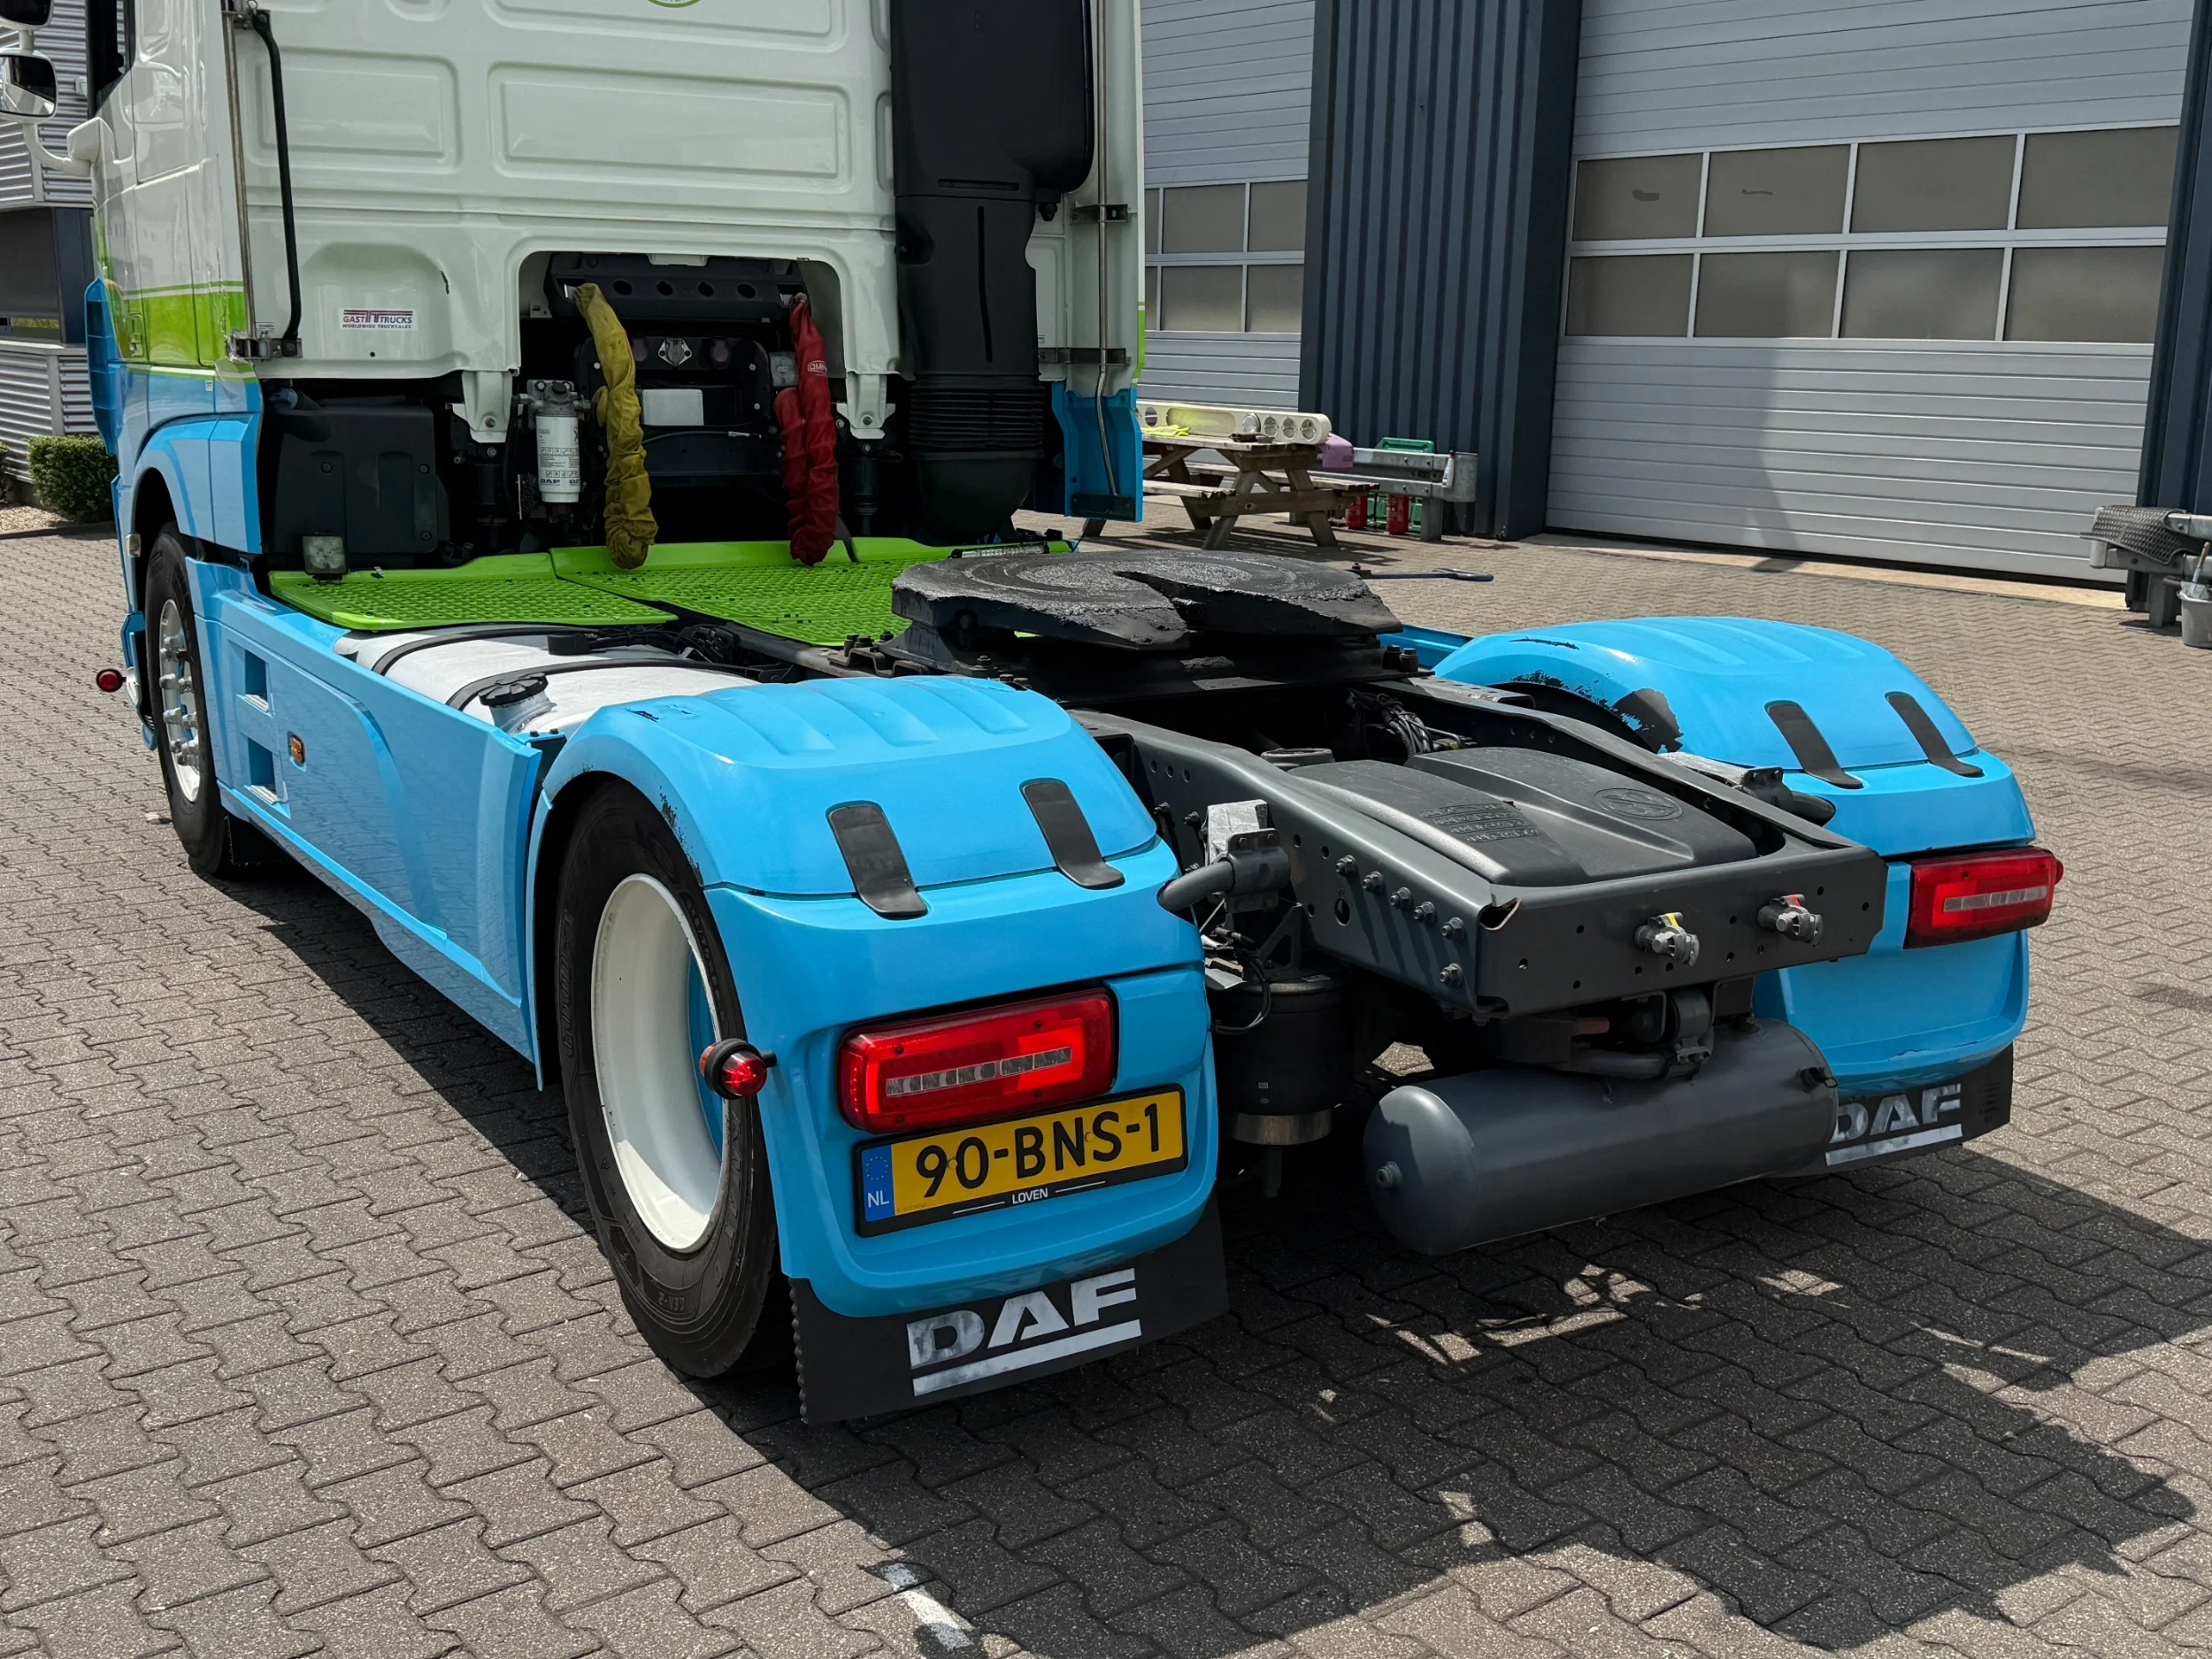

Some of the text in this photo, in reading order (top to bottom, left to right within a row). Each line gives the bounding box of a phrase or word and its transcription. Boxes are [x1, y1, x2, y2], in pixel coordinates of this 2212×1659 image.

[1830, 1083, 1962, 1144] DAF
[916, 1103, 1158, 1198] 90-BNS-1
[868, 1190, 890, 1209] NL
[1011, 1187, 1048, 1204] LOVEN
[658, 1292, 685, 1311] GEN-2
[907, 1268, 1138, 1370] DAF
